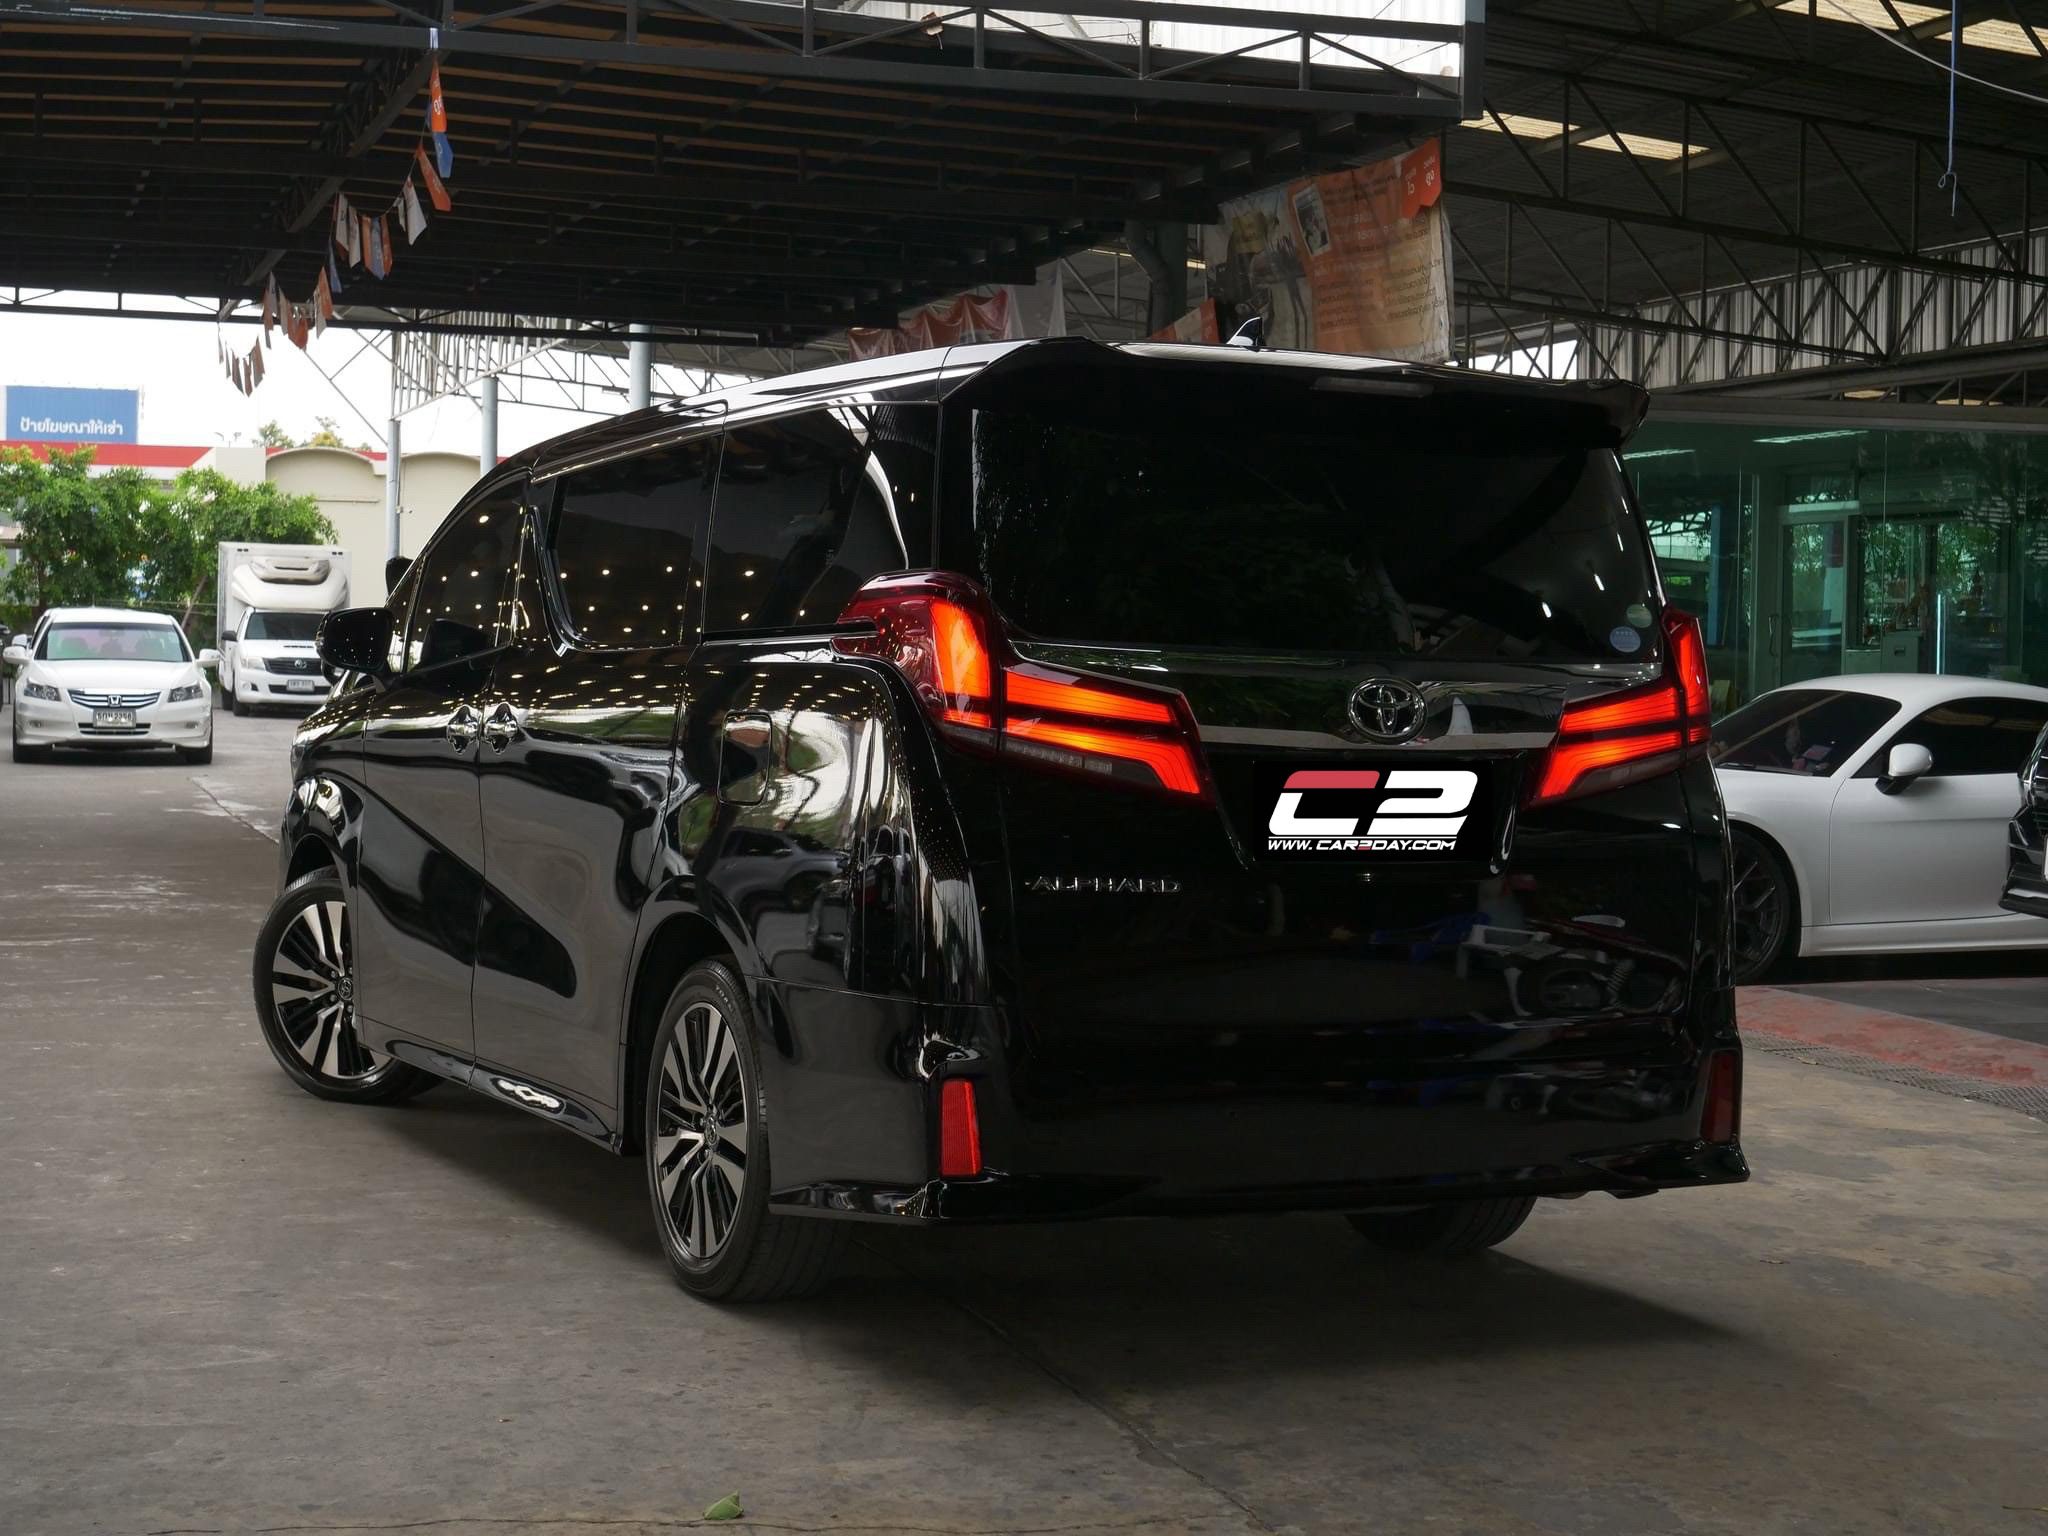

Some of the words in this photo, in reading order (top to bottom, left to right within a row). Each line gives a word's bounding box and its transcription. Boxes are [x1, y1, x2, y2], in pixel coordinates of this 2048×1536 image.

[20, 416, 124, 435] ป้ายโฆษณาให้เช่า
[1025, 876, 1182, 893] ALPHARD
